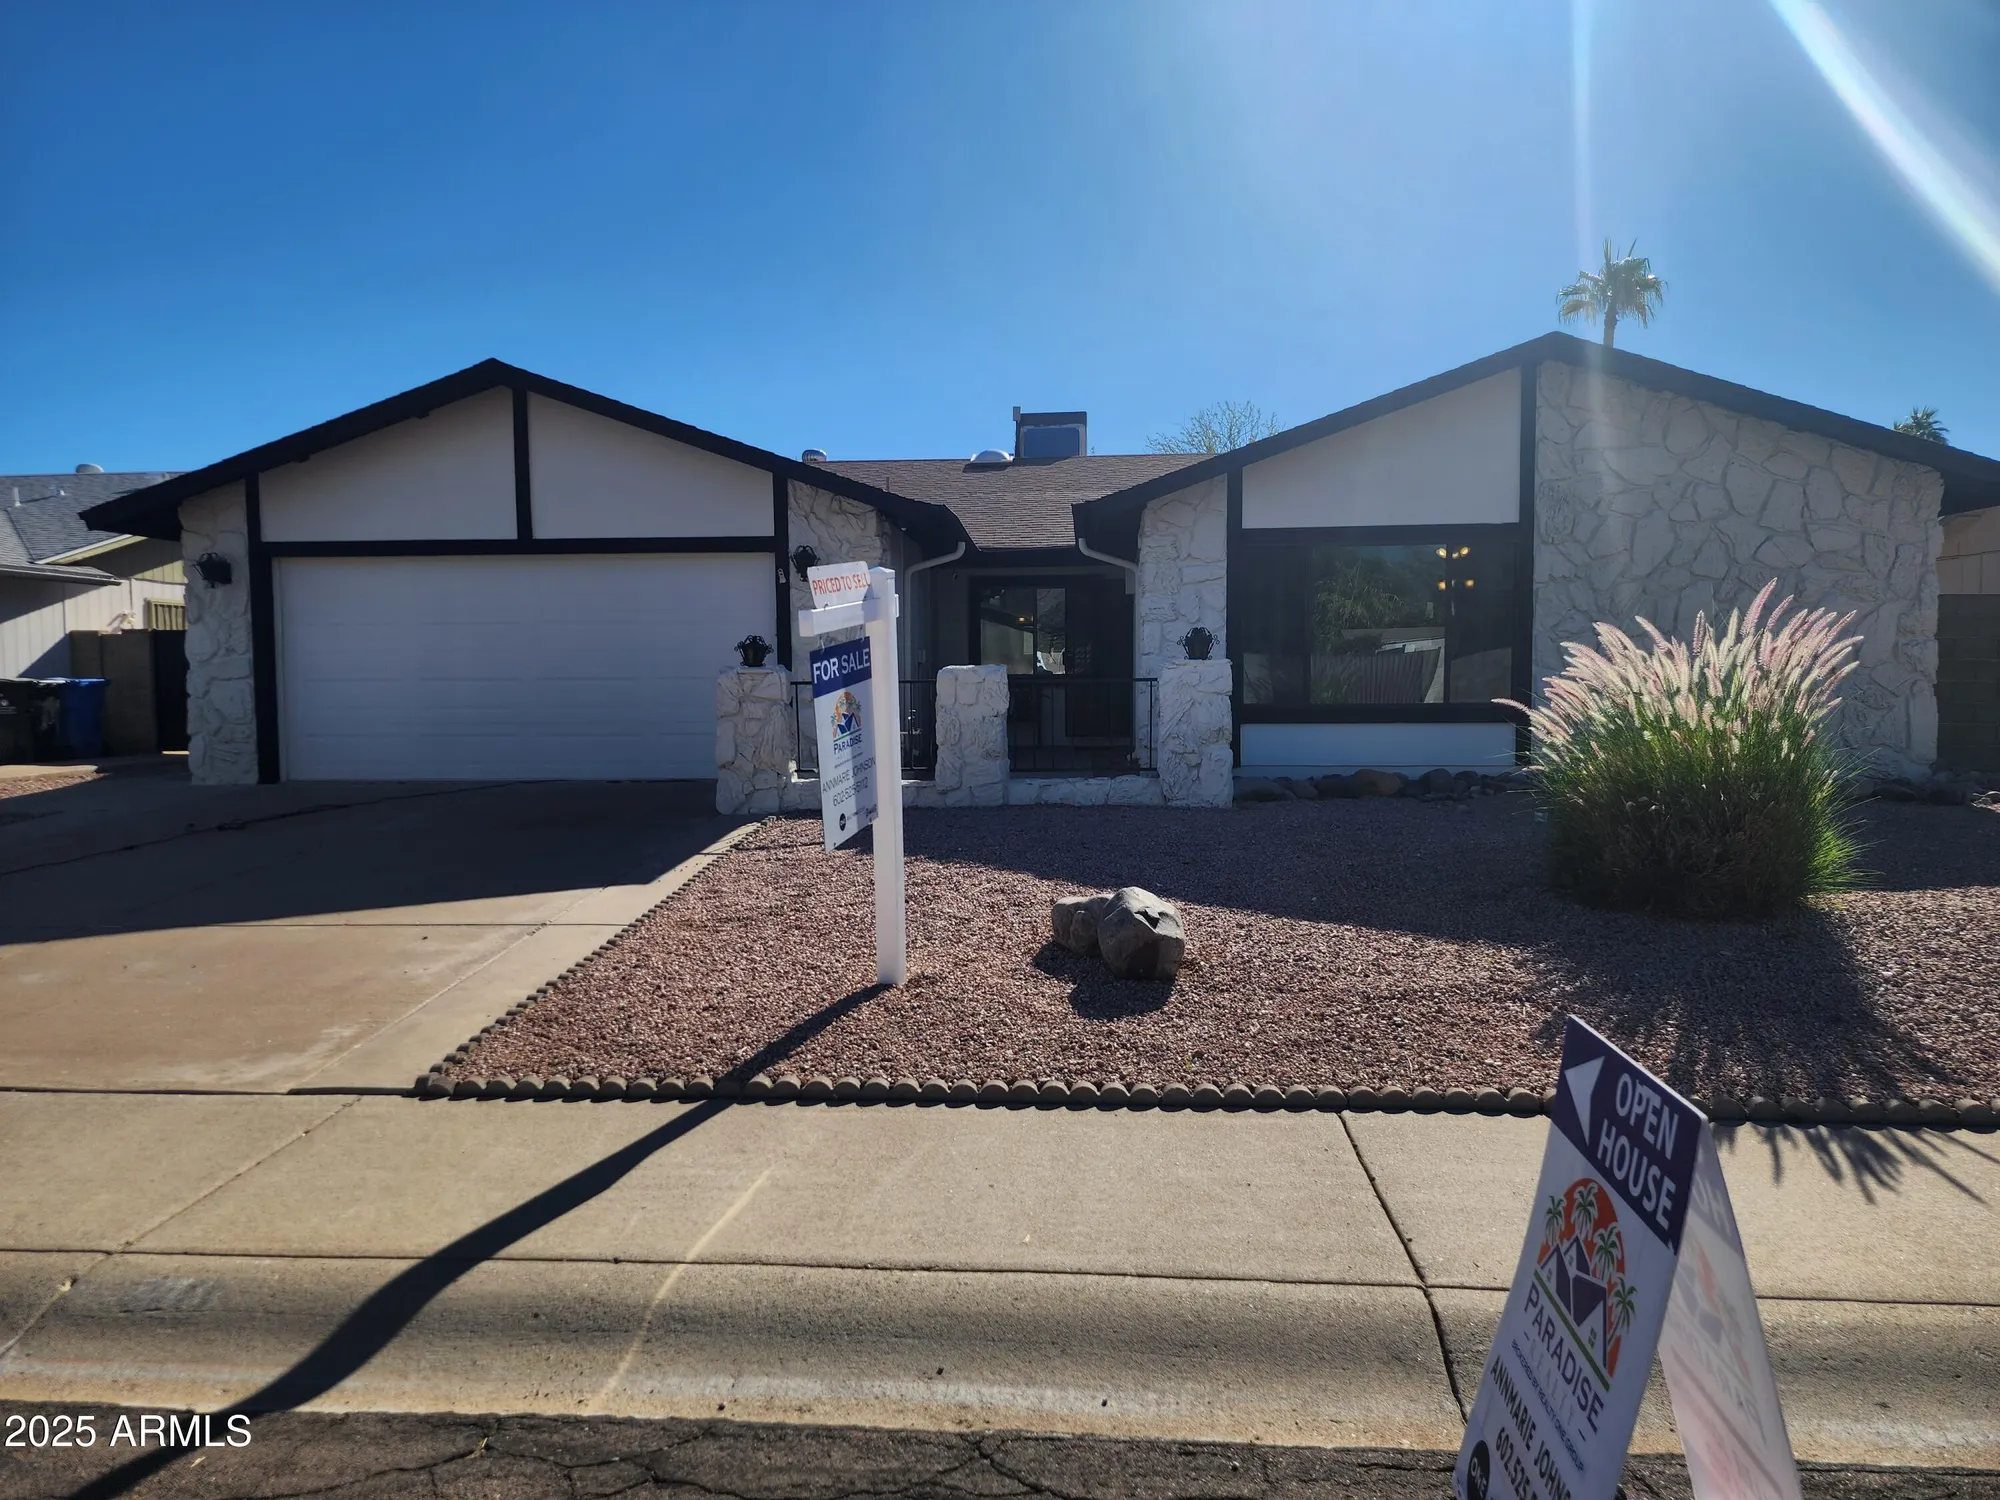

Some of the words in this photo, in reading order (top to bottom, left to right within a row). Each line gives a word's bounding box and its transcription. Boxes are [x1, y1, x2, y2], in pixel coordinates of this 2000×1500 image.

[811, 577, 841, 596] PRICED
[840, 576, 852, 591] TO
[853, 572, 870, 589] SELL
[812, 657, 840, 684] FOR
[841, 648, 871, 675] SALE
[833, 733, 863, 755] PARADISE
[1615, 1072, 1679, 1161] OPEN
[1597, 1118, 1676, 1231] HOUSE
[1524, 1281, 1604, 1434] PARADISE
[1529, 1338, 1576, 1427] REALTY
[1490, 1354, 1537, 1451] ANNMARIE
